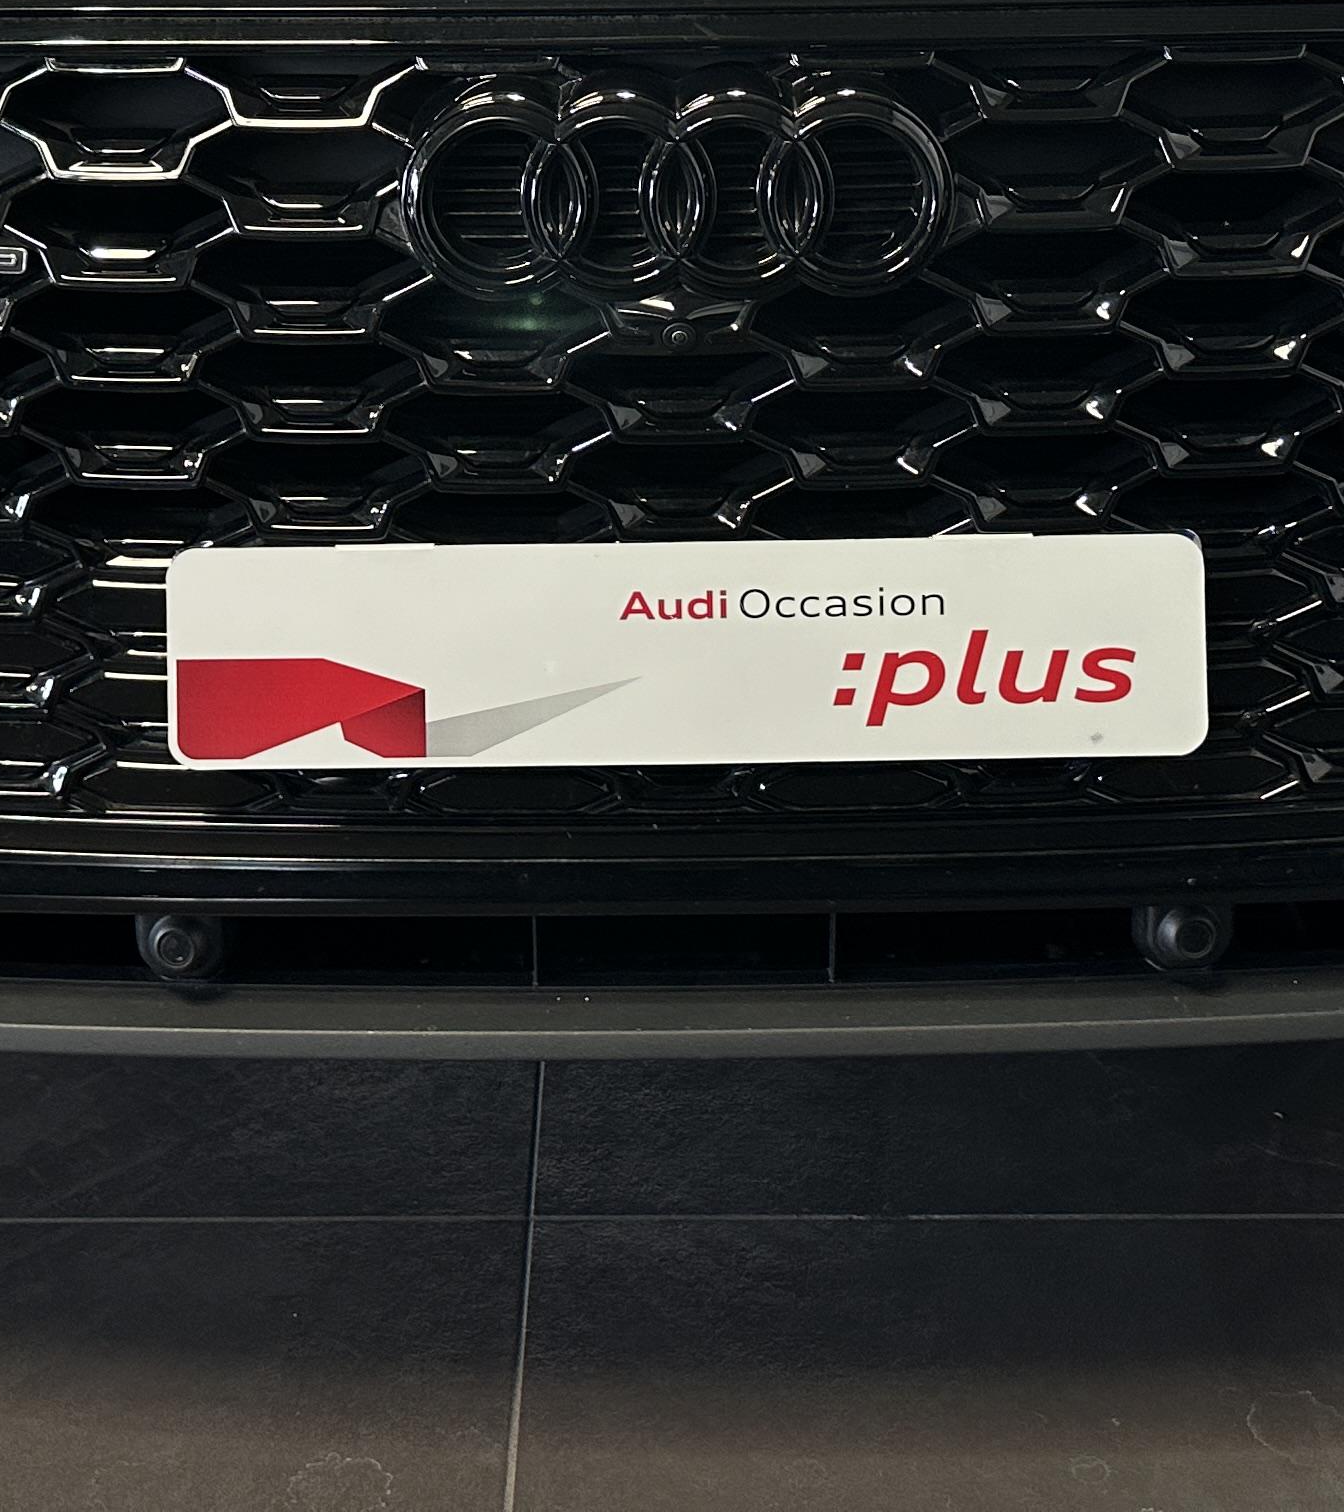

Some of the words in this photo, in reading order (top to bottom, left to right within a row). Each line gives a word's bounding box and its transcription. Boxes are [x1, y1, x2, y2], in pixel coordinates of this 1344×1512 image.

[620, 589, 728, 620] Audi
[739, 586, 945, 619] Occasion
[833, 629, 1136, 727] :plus
